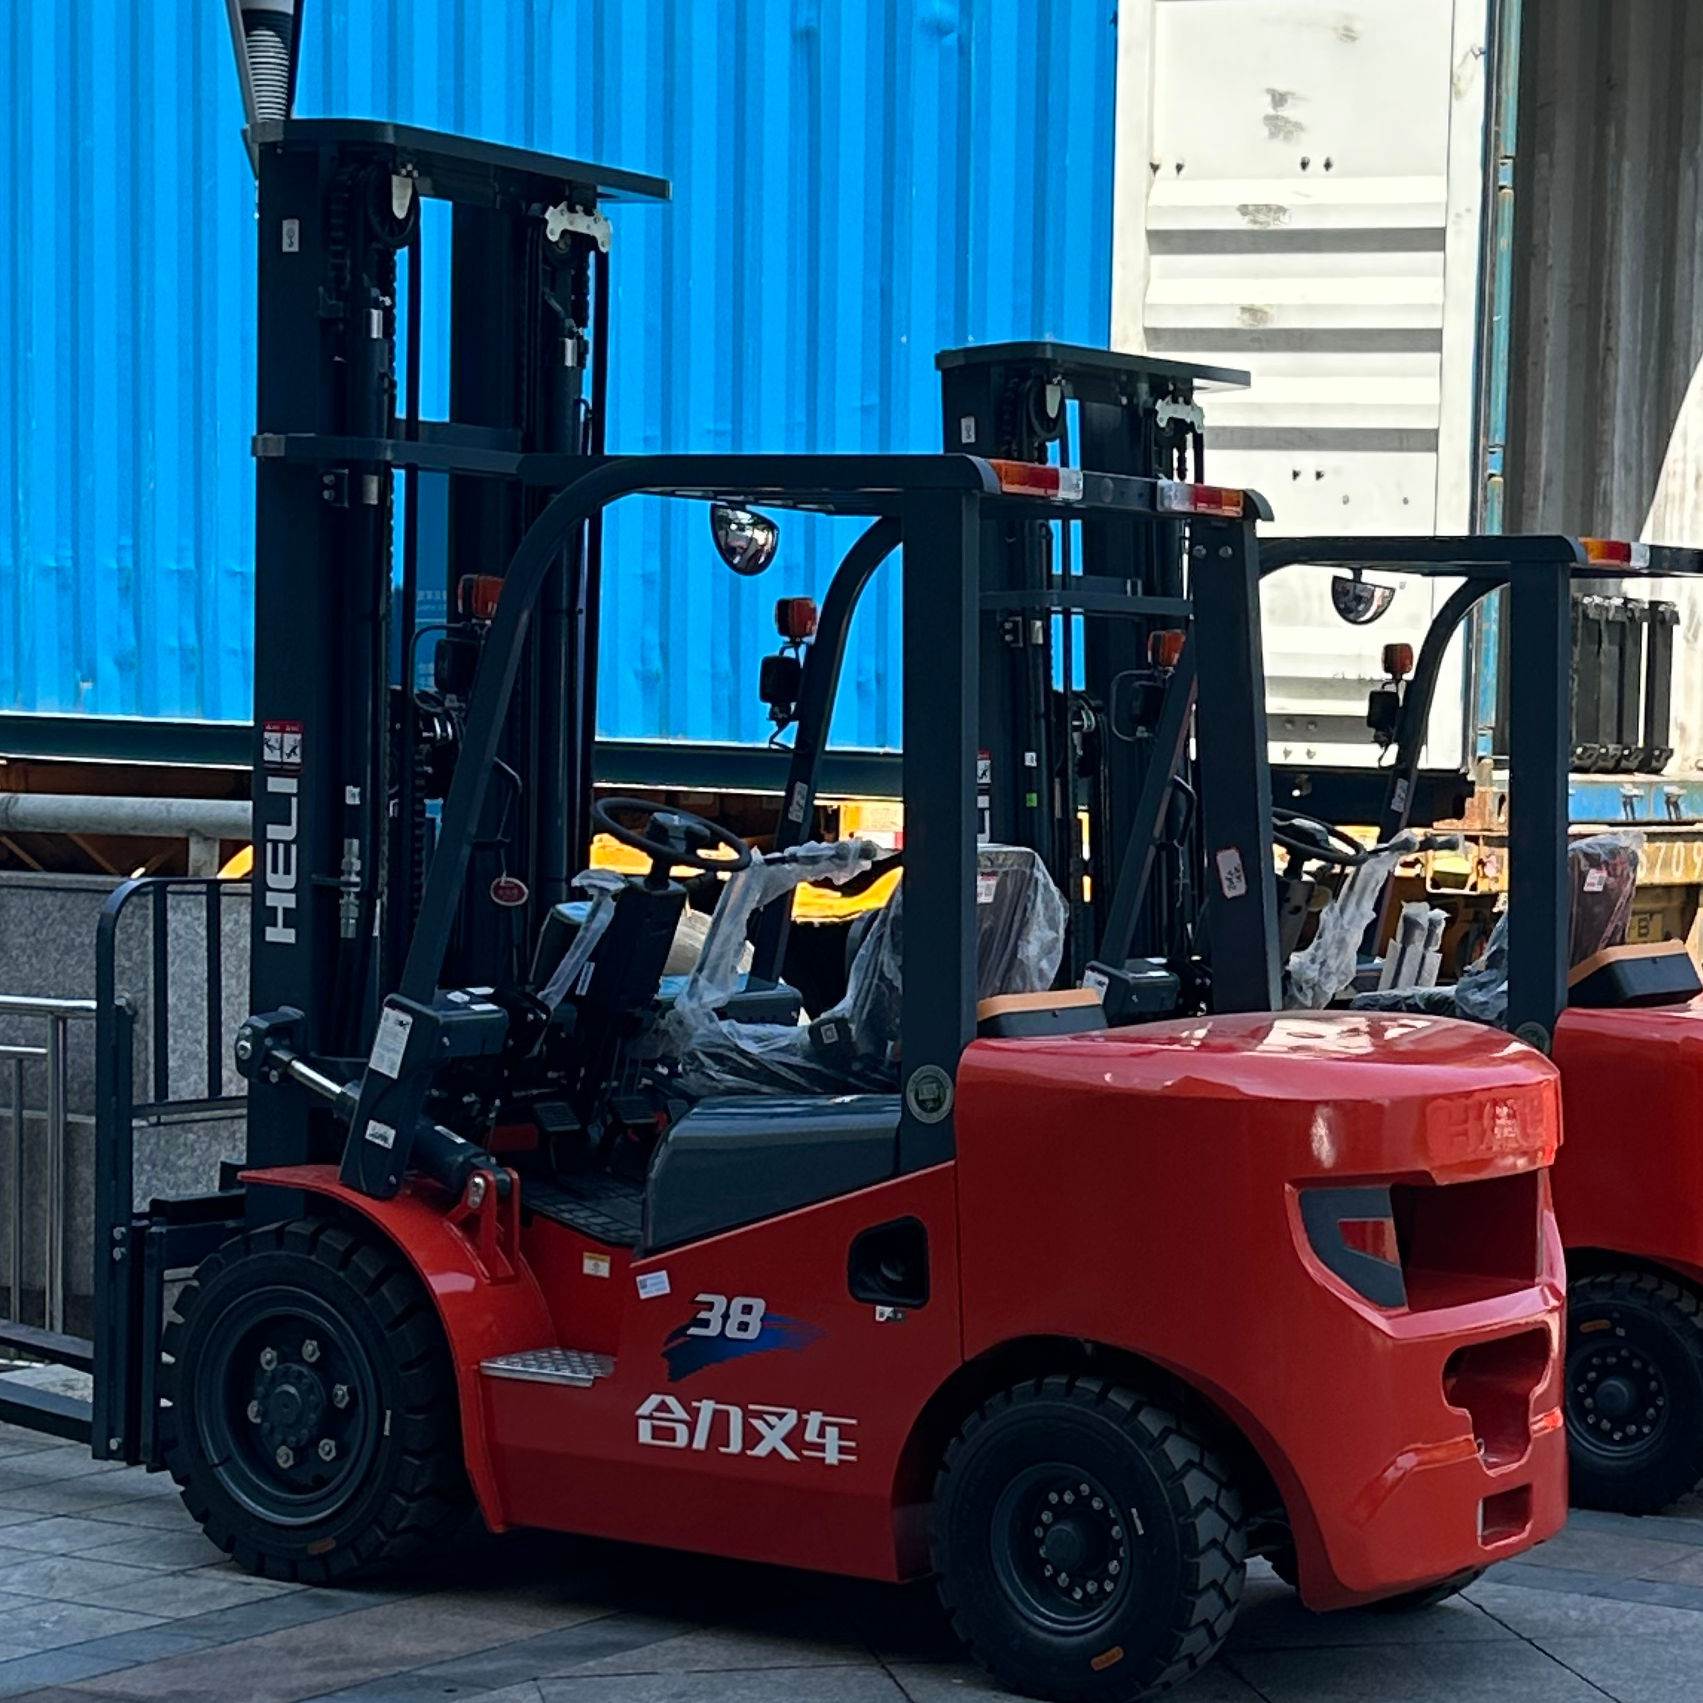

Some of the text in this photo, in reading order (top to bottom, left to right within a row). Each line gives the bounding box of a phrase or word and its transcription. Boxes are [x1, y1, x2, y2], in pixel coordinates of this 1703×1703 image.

[265, 776, 298, 943] HELI
[686, 1292, 767, 1340] 38
[634, 1393, 858, 1466] 合力叉车
